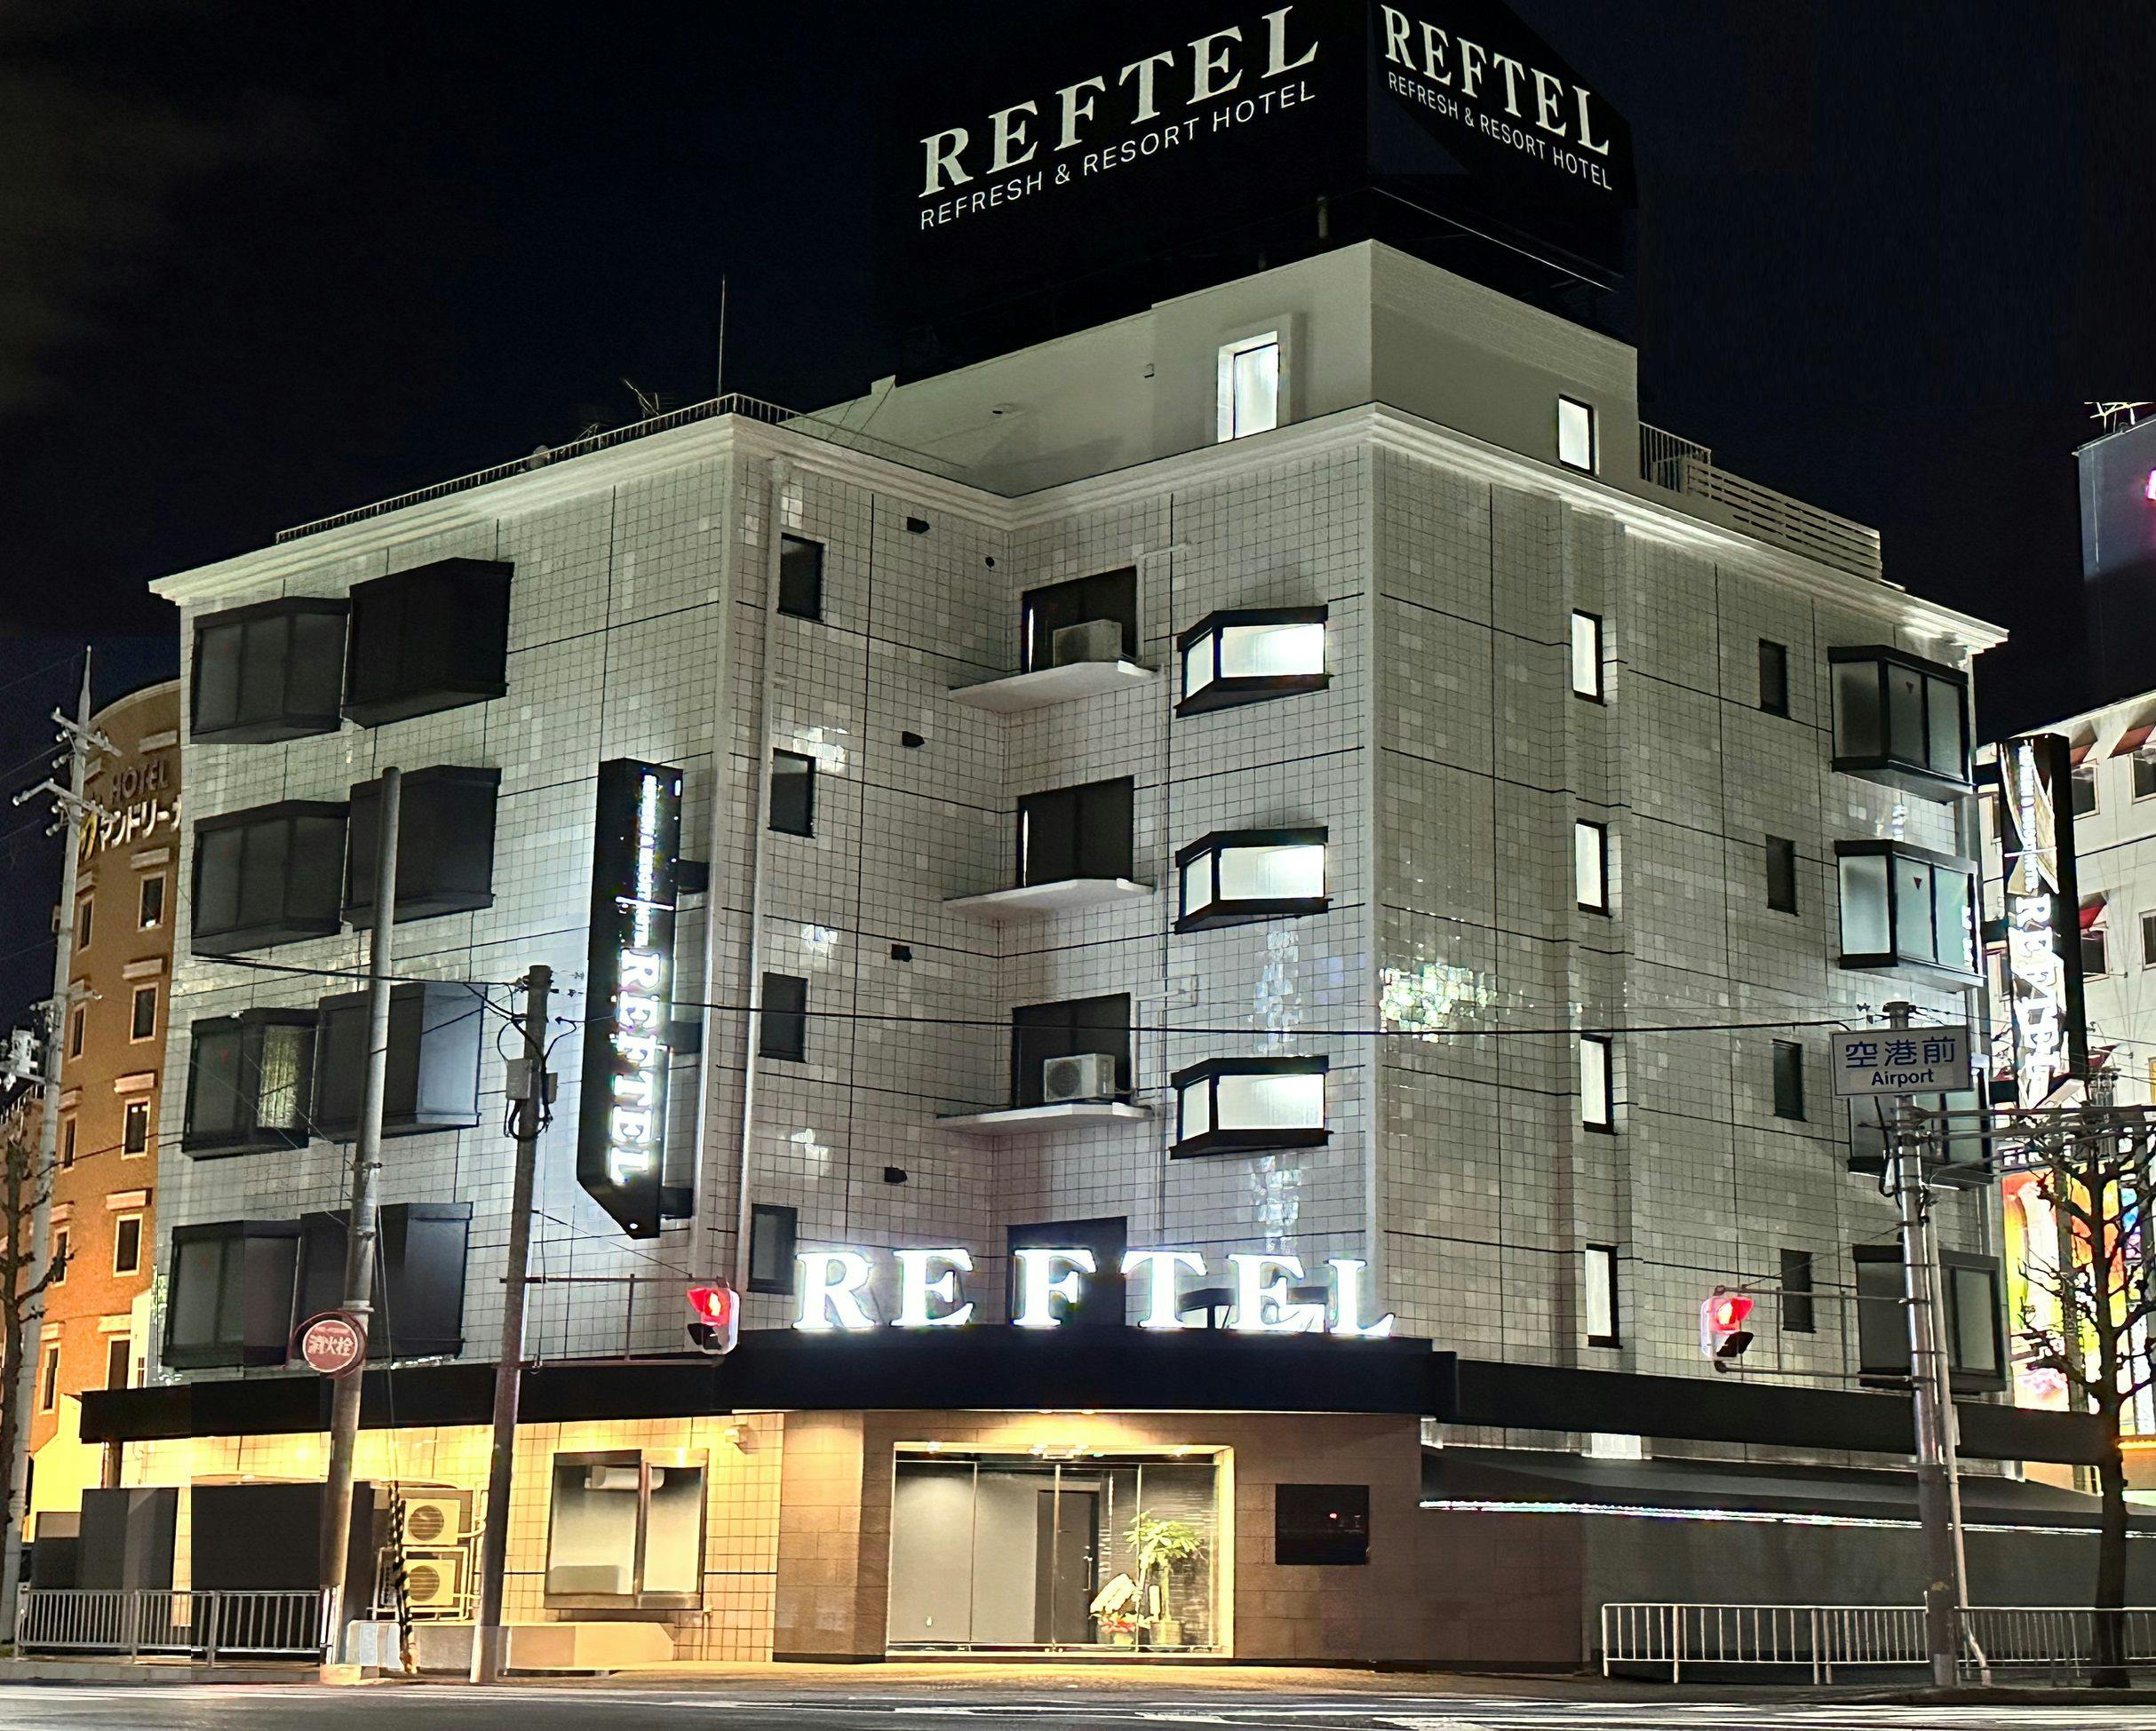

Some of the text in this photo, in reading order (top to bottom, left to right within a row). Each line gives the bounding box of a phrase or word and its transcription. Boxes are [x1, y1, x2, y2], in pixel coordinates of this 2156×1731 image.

[918, 4, 1319, 199] REFTEL
[1380, 4, 1610, 156] REFTEL
[1388, 71, 1613, 191] REFRESH & RESORT HOTEL
[920, 81, 1316, 230] REFRESH & RESORT HOTEL
[112, 759, 169, 805] HOTEL
[609, 949, 661, 1186] REFTEL
[1845, 1036, 1956, 1068] 空港前
[1871, 1068, 1935, 1086] Airport
[791, 1247, 1396, 1336] REFTEL
